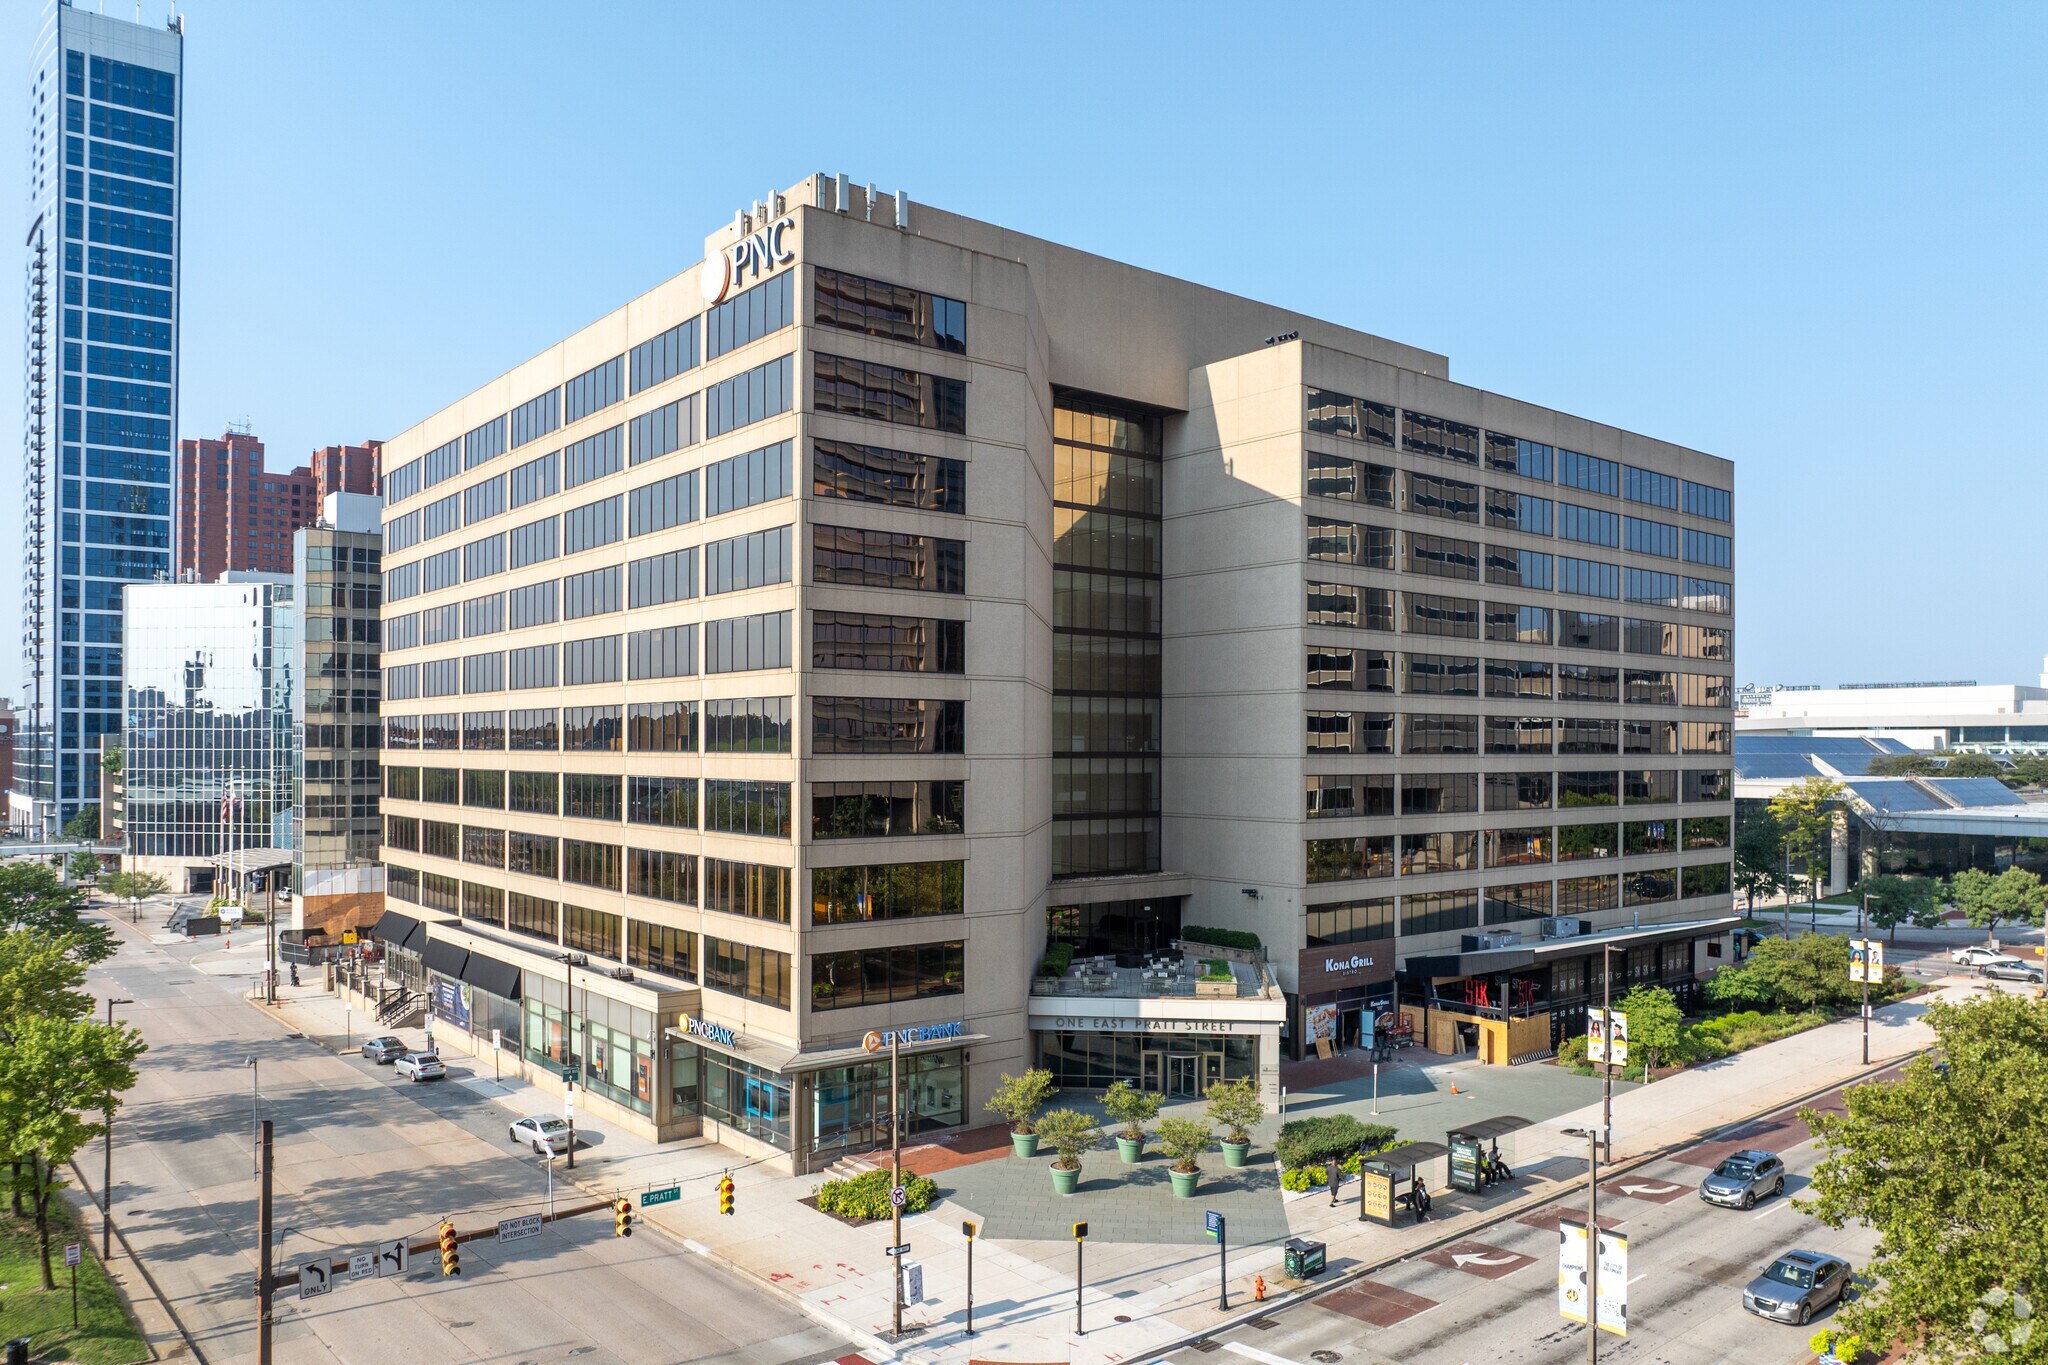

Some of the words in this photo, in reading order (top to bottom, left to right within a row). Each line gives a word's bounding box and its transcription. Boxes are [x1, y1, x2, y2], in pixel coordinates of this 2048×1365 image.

[730, 218, 795, 286] PNC
[1464, 978, 1489, 1008] STK
[1055, 1017, 1084, 1028] ONE
[1093, 1018, 1126, 1029] EAST
[1135, 1019, 1177, 1030] PRATT
[1185, 1020, 1234, 1031] STREET
[642, 1195, 649, 1204] E
[650, 1190, 672, 1203] PRATT
[500, 1223, 509, 1231] DO
[510, 1220, 520, 1229] NOT
[522, 1216, 540, 1226] BLOCK
[501, 1227, 540, 1240] INTERSECTION
[361, 1267, 373, 1275] RED
[304, 1283, 328, 1296] ONLY
